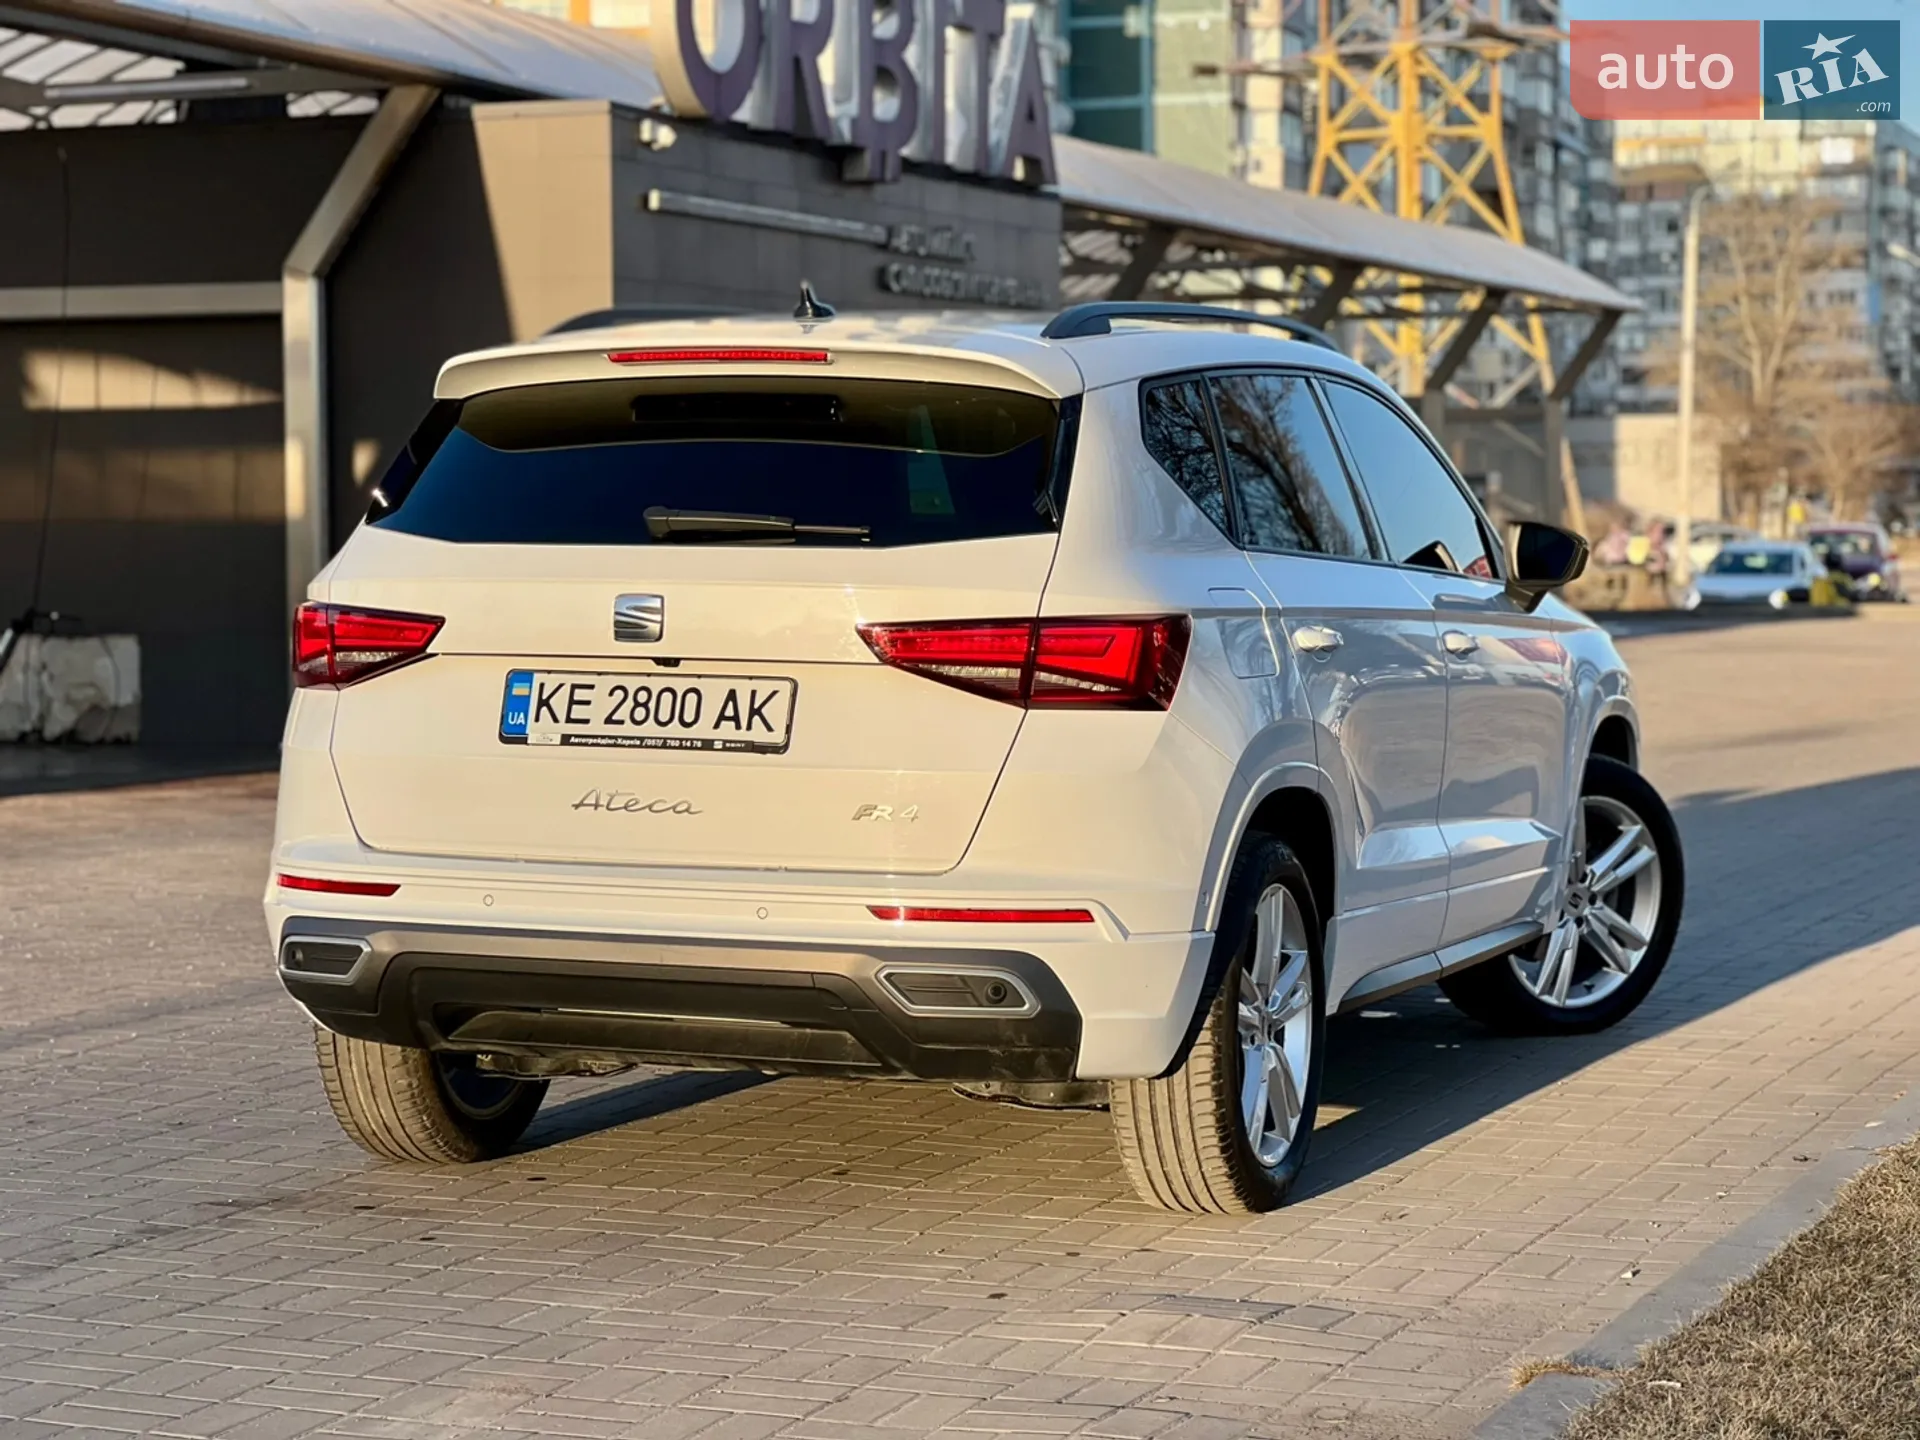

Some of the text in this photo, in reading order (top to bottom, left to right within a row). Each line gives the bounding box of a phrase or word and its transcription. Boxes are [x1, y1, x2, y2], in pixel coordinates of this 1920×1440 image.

[676, 0, 1057, 185] ORBITA
[507, 711, 526, 726] UA
[533, 681, 780, 733] KE 2800 AK
[571, 789, 704, 816] Ateca
[851, 804, 919, 823] FR 4
